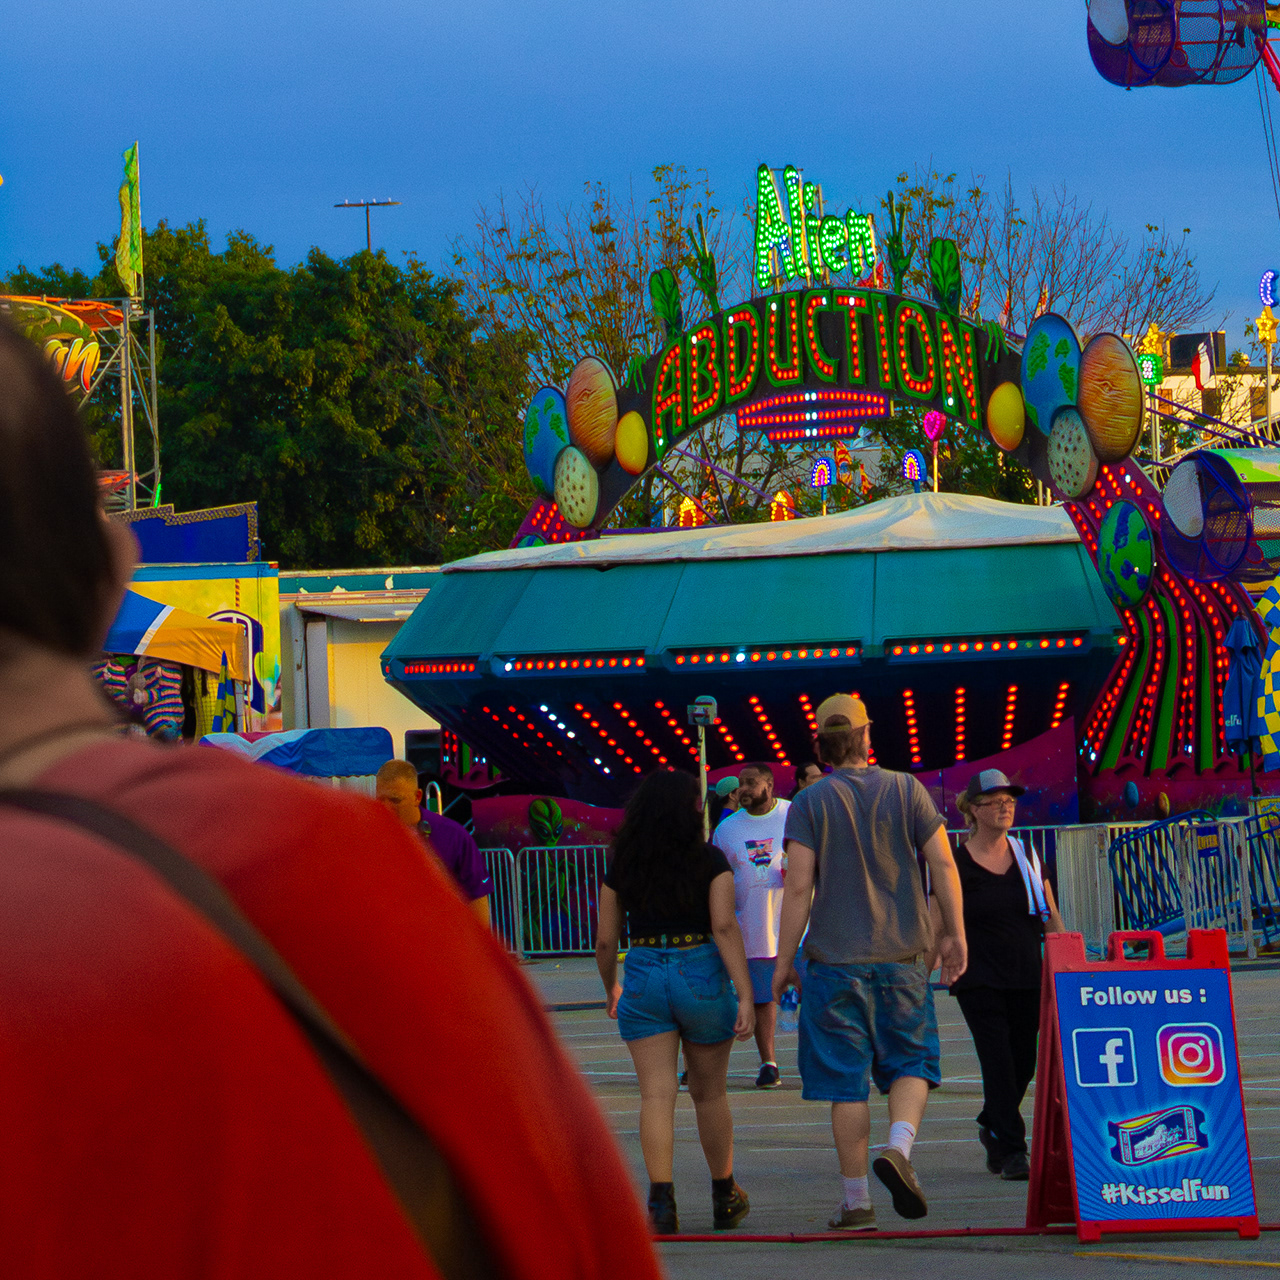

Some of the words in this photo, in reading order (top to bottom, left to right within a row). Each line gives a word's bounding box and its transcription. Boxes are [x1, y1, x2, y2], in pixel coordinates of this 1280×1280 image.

[754, 163, 877, 289] Alien
[652, 287, 982, 461] ABDUCTION
[1081, 987, 1157, 1006] Follow
[1165, 990, 1193, 1004] us
[1101, 1178, 1230, 1205] #KisselFun
